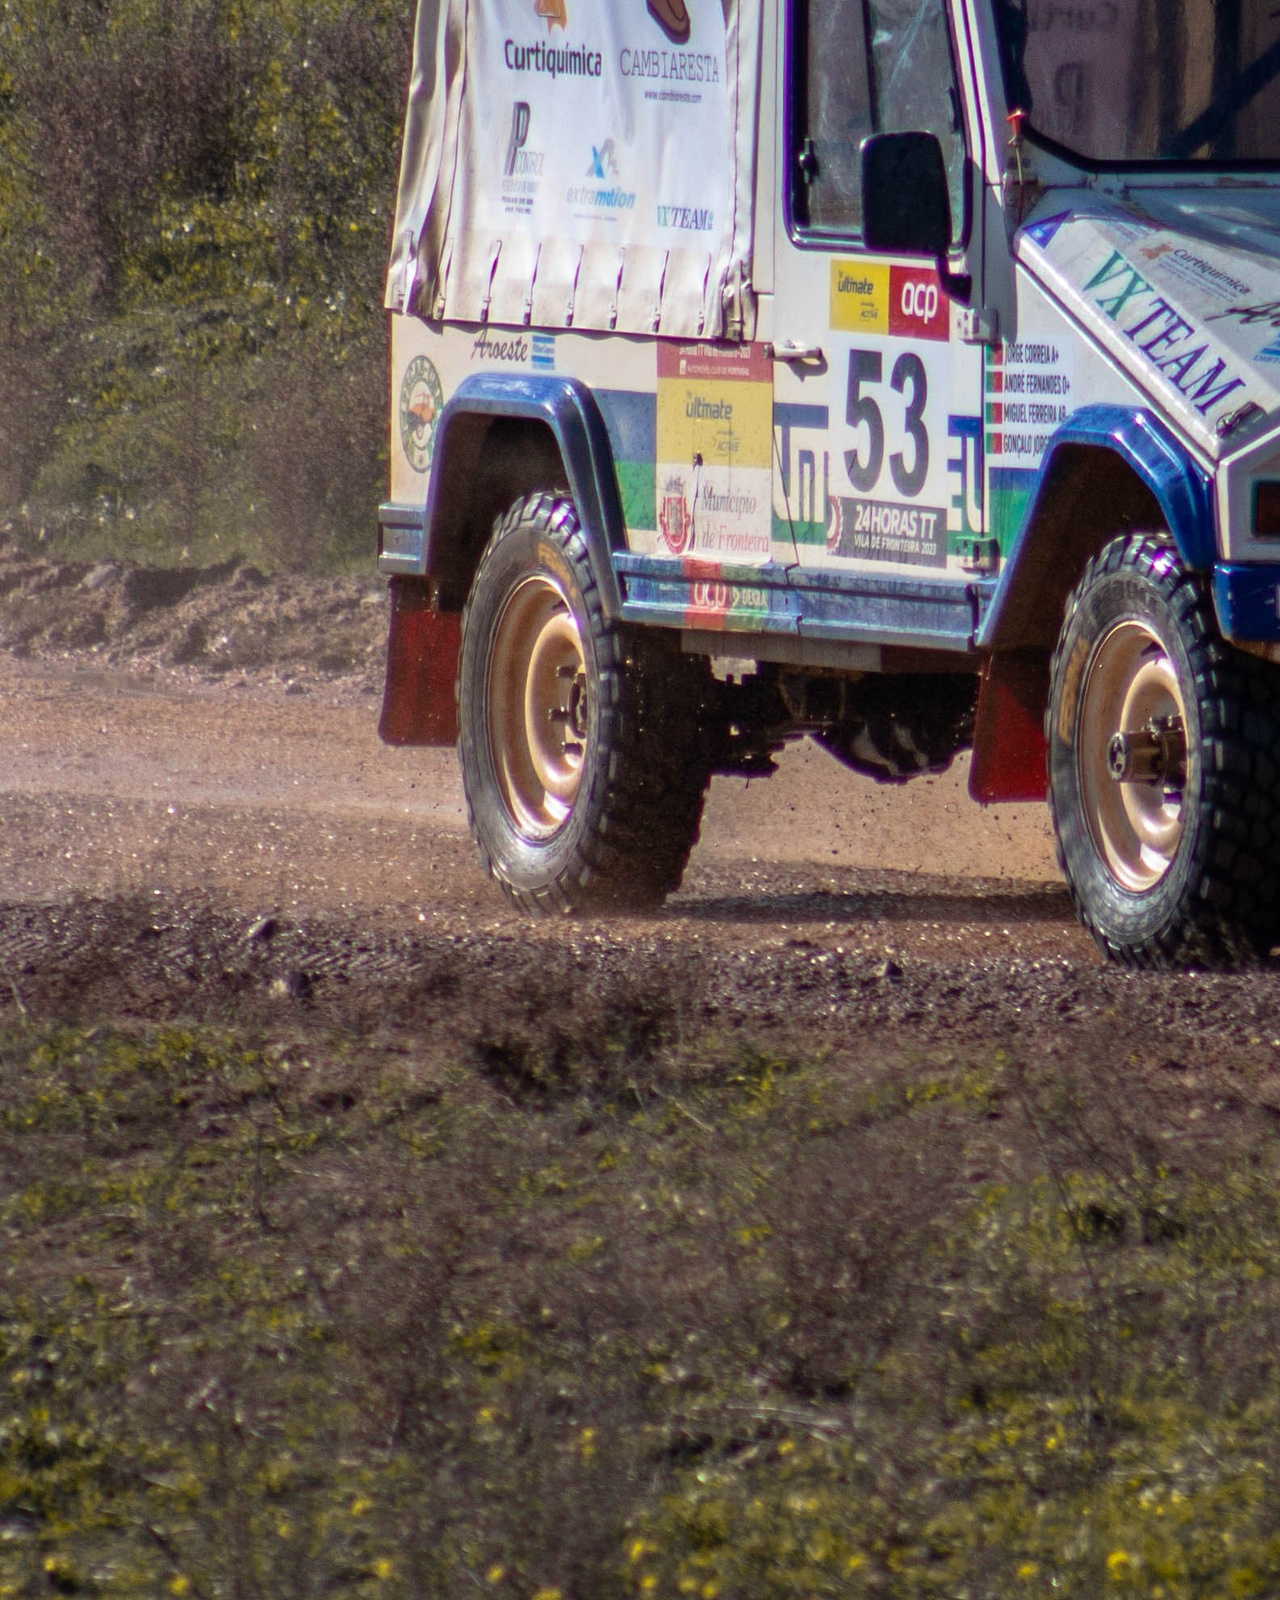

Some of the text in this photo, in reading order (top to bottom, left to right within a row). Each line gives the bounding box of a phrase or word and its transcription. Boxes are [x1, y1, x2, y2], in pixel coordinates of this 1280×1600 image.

[504, 38, 602, 79] Curtiquímica
[619, 48, 720, 83] CAMBIARESTA
[838, 275, 874, 295] ultimate
[902, 281, 938, 324] acp
[471, 329, 528, 362] Aroeste
[1082, 249, 1155, 321] VX
[1123, 296, 1247, 416] TEAM
[1005, 344, 1023, 366] JORGE
[1025, 344, 1050, 364] CORREIA
[1004, 369, 1025, 394] ANDRÉ
[1027, 373, 1062, 395] FERNANDES
[686, 396, 733, 420] ultimate
[1003, 402, 1027, 423] MIGUEL
[1028, 403, 1057, 424] FERREIRA
[843, 348, 929, 498] 53
[1003, 433, 1032, 460] GONÇALO
[702, 524, 769, 552] de Fronteira
[920, 512, 937, 539] TT
[854, 534, 870, 548] VILA
[871, 536, 880, 548] DE
[882, 537, 920, 553] FRONTEIRA
